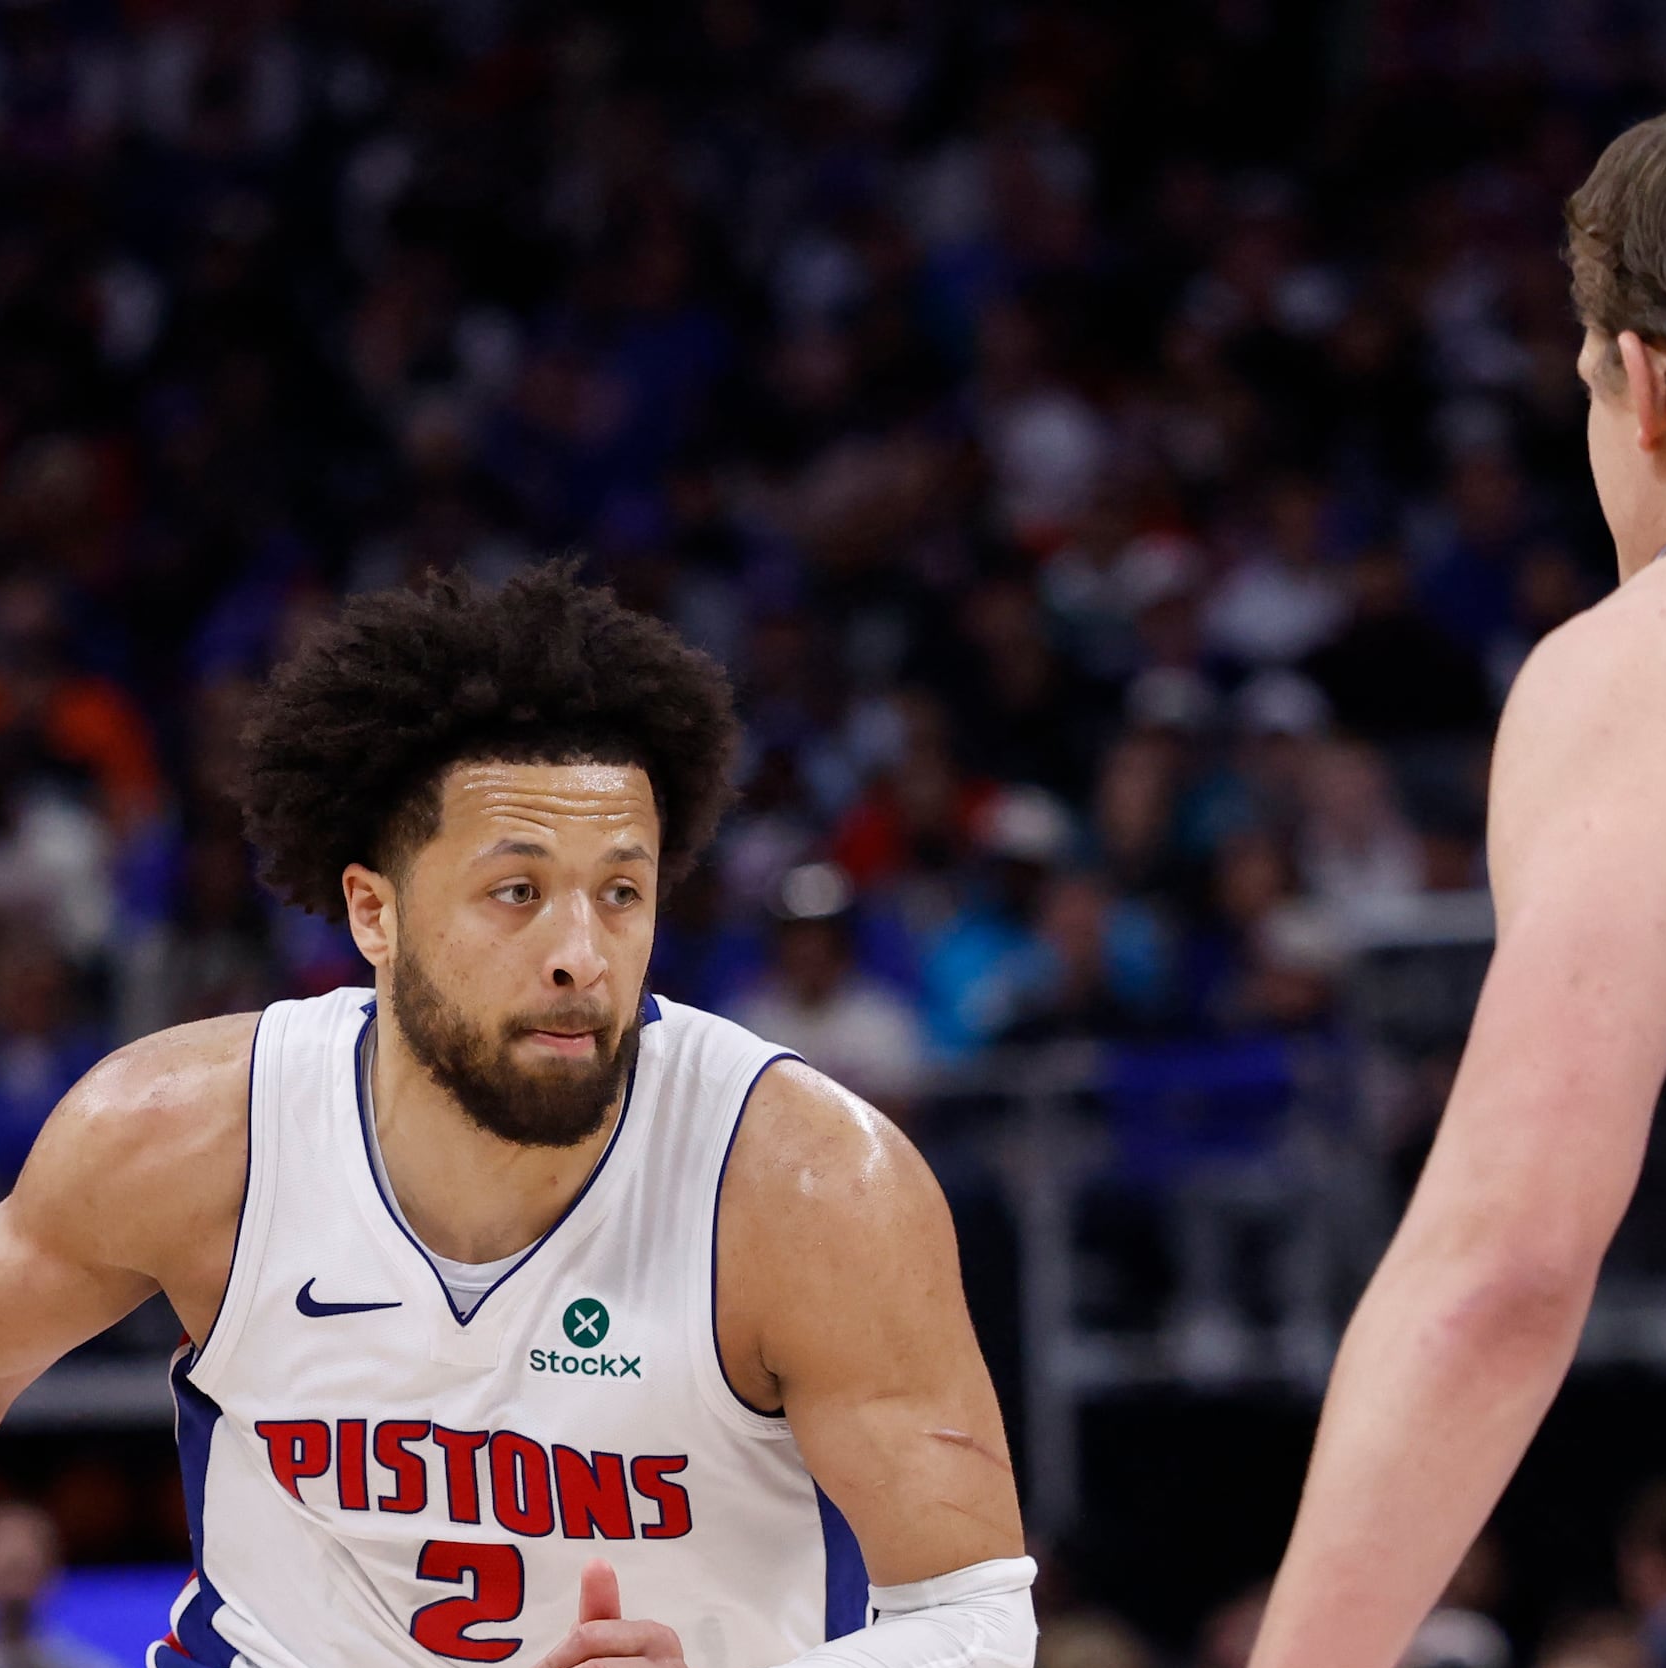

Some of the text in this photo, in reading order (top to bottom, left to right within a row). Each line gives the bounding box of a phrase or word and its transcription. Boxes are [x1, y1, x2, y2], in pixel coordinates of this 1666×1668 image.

[529, 1348, 642, 1379] StockX
[254, 1417, 694, 1541] PISTONS
[408, 1540, 526, 1664] 2
